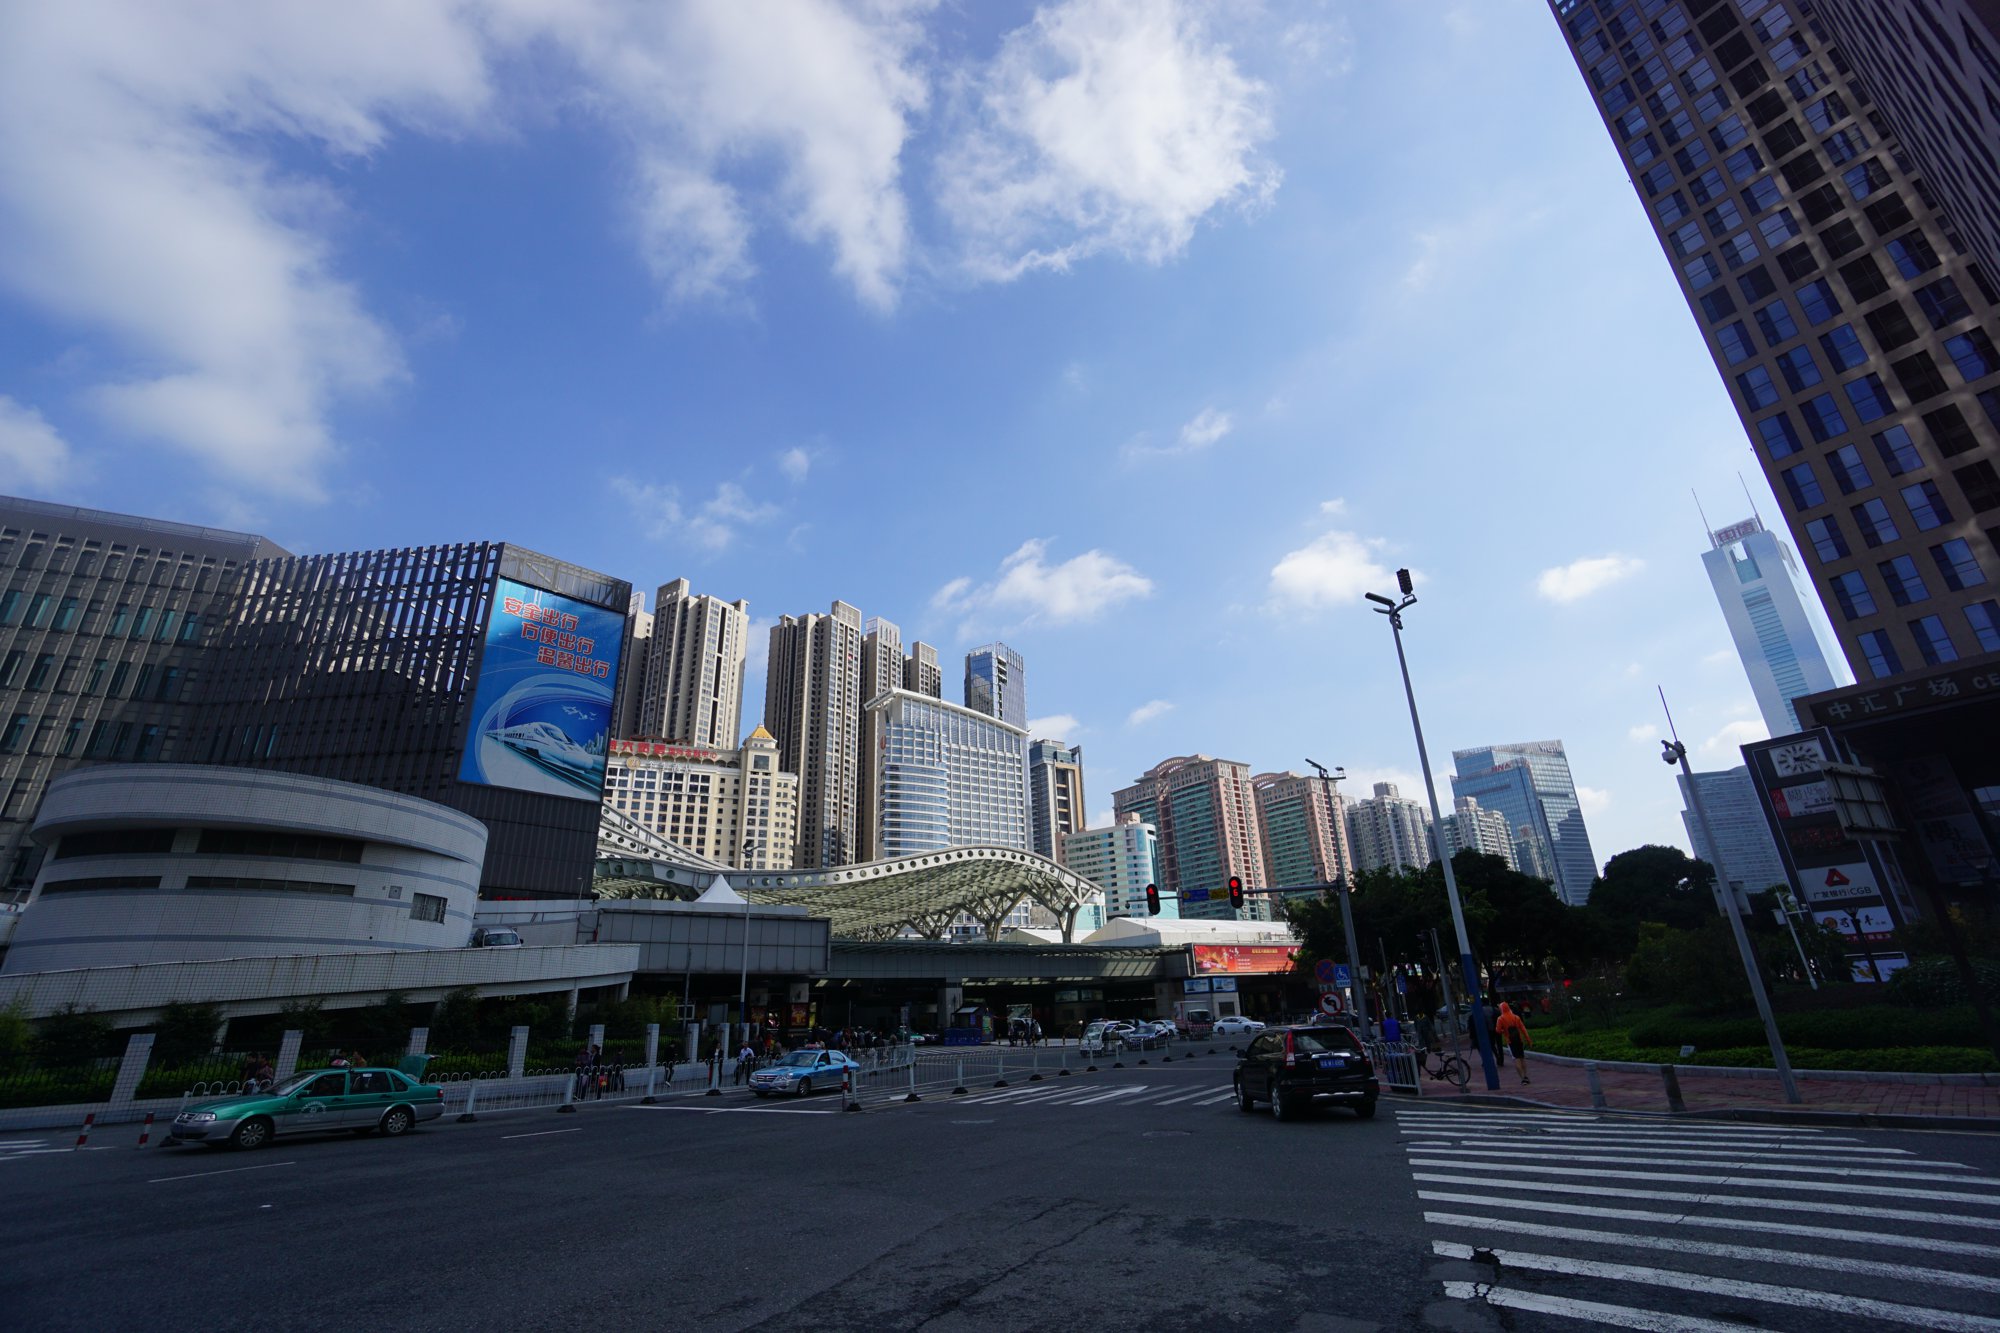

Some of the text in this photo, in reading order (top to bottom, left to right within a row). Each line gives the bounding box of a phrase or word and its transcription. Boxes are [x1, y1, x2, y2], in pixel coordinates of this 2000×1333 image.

[502, 597, 579, 632] 安全出行
[521, 621, 595, 655] 方便出行
[537, 646, 611, 678] 温馨出行
[1827, 677, 1960, 720] 中汇广场
[1813, 886, 1872, 899] 广发银行 CGB
